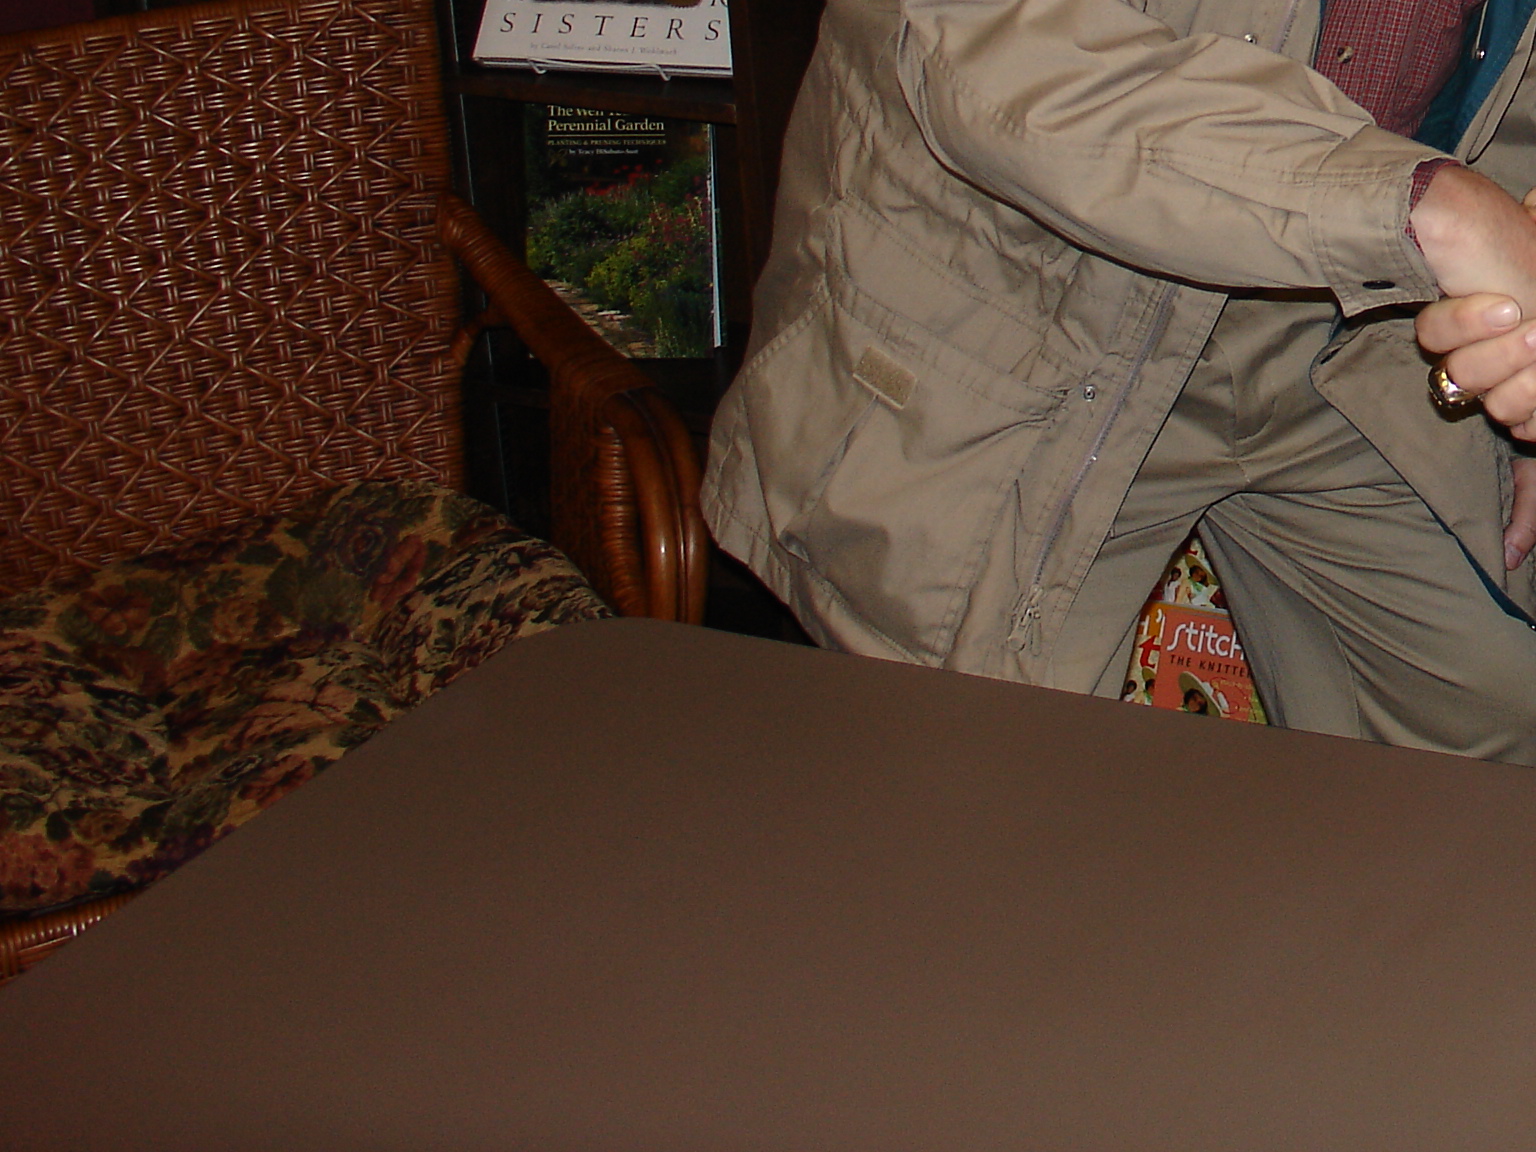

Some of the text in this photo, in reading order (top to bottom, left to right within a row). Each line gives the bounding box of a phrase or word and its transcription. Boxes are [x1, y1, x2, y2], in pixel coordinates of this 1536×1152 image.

[500, 13, 721, 41] SISTERS
[547, 105, 573, 116] The
[548, 118, 665, 131] Perennial Garden
[1170, 654, 1191, 668] THE
